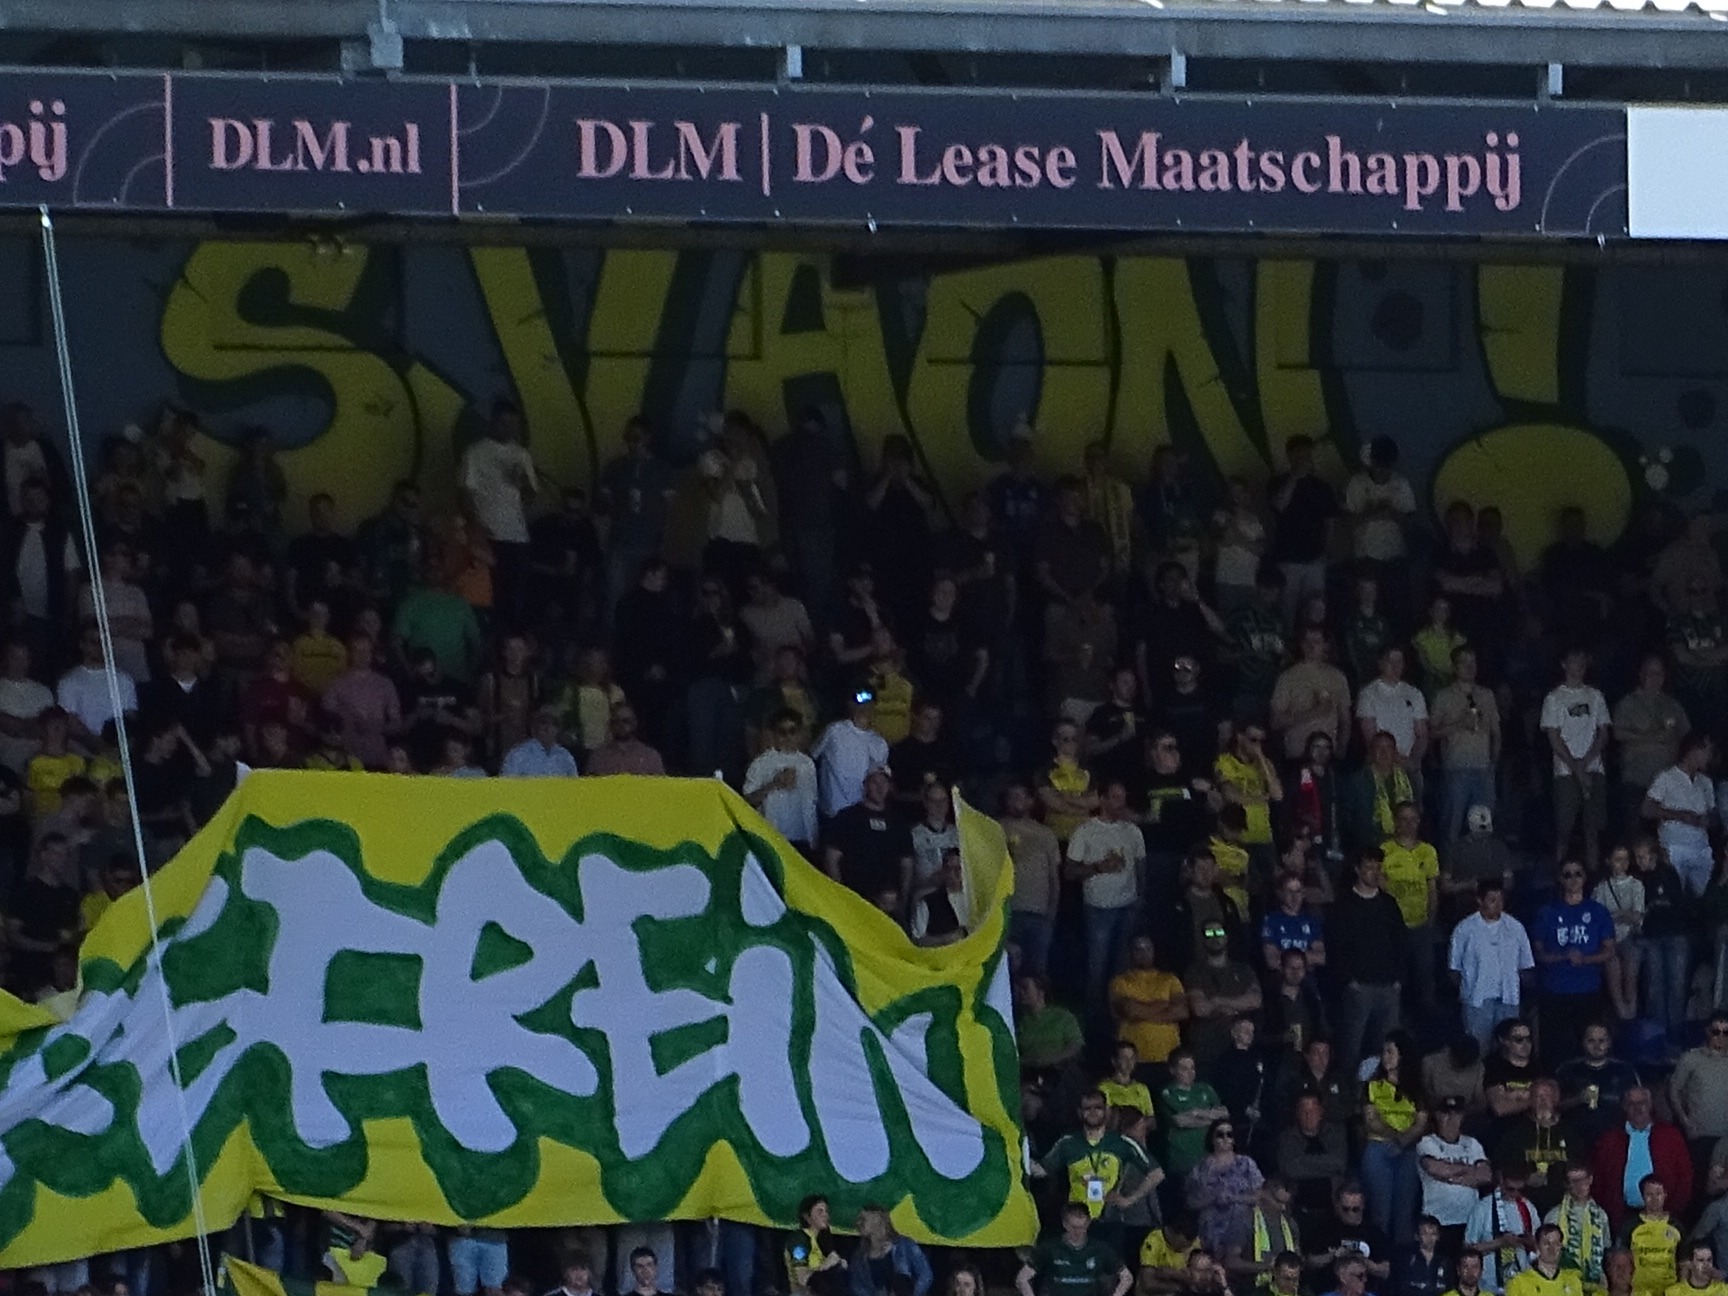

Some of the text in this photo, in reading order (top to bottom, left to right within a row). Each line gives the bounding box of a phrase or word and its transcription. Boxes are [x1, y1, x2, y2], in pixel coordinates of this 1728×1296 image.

[209, 116, 422, 174] DLM.nl
[576, 116, 1522, 213] DLM Dé Lease Maatschappij
